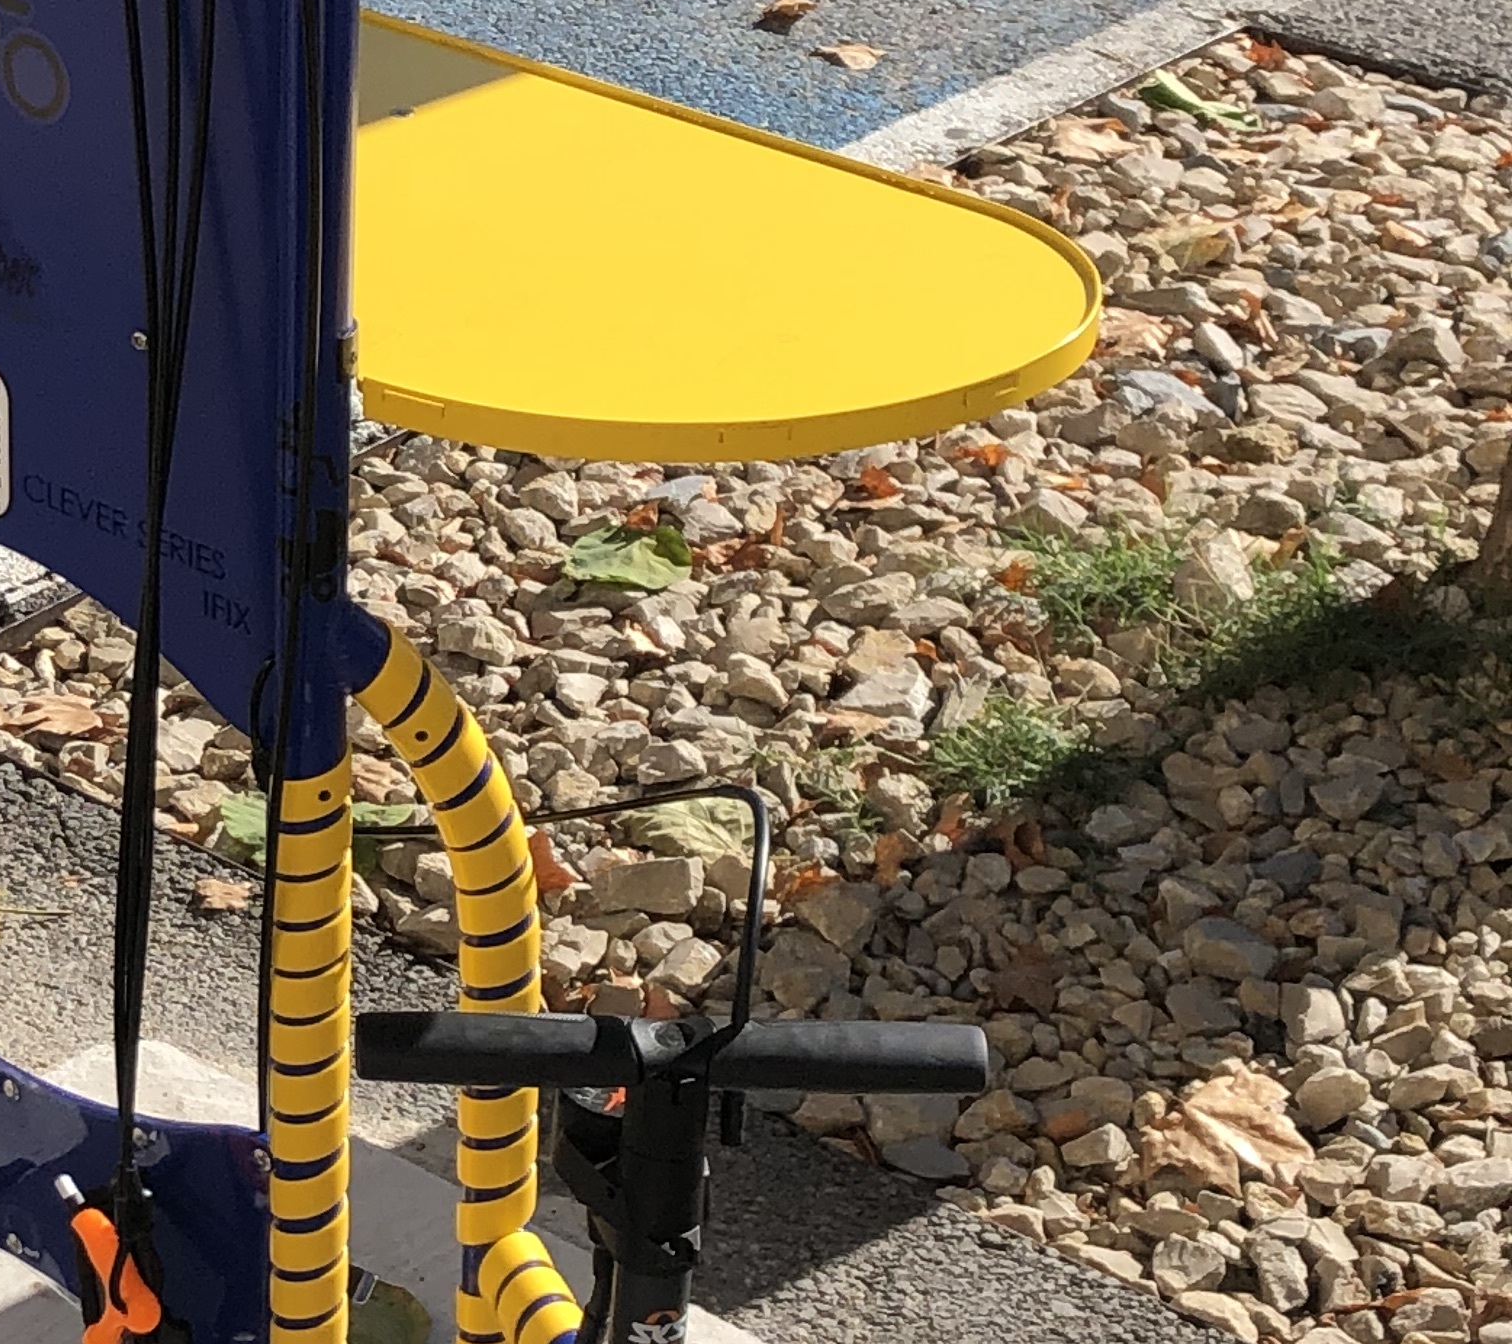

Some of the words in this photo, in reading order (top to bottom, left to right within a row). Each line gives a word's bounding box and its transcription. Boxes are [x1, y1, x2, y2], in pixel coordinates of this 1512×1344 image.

[23, 474, 128, 539] CLEVER
[203, 591, 251, 636] IFIX
[627, 1313, 688, 1344] SKS
